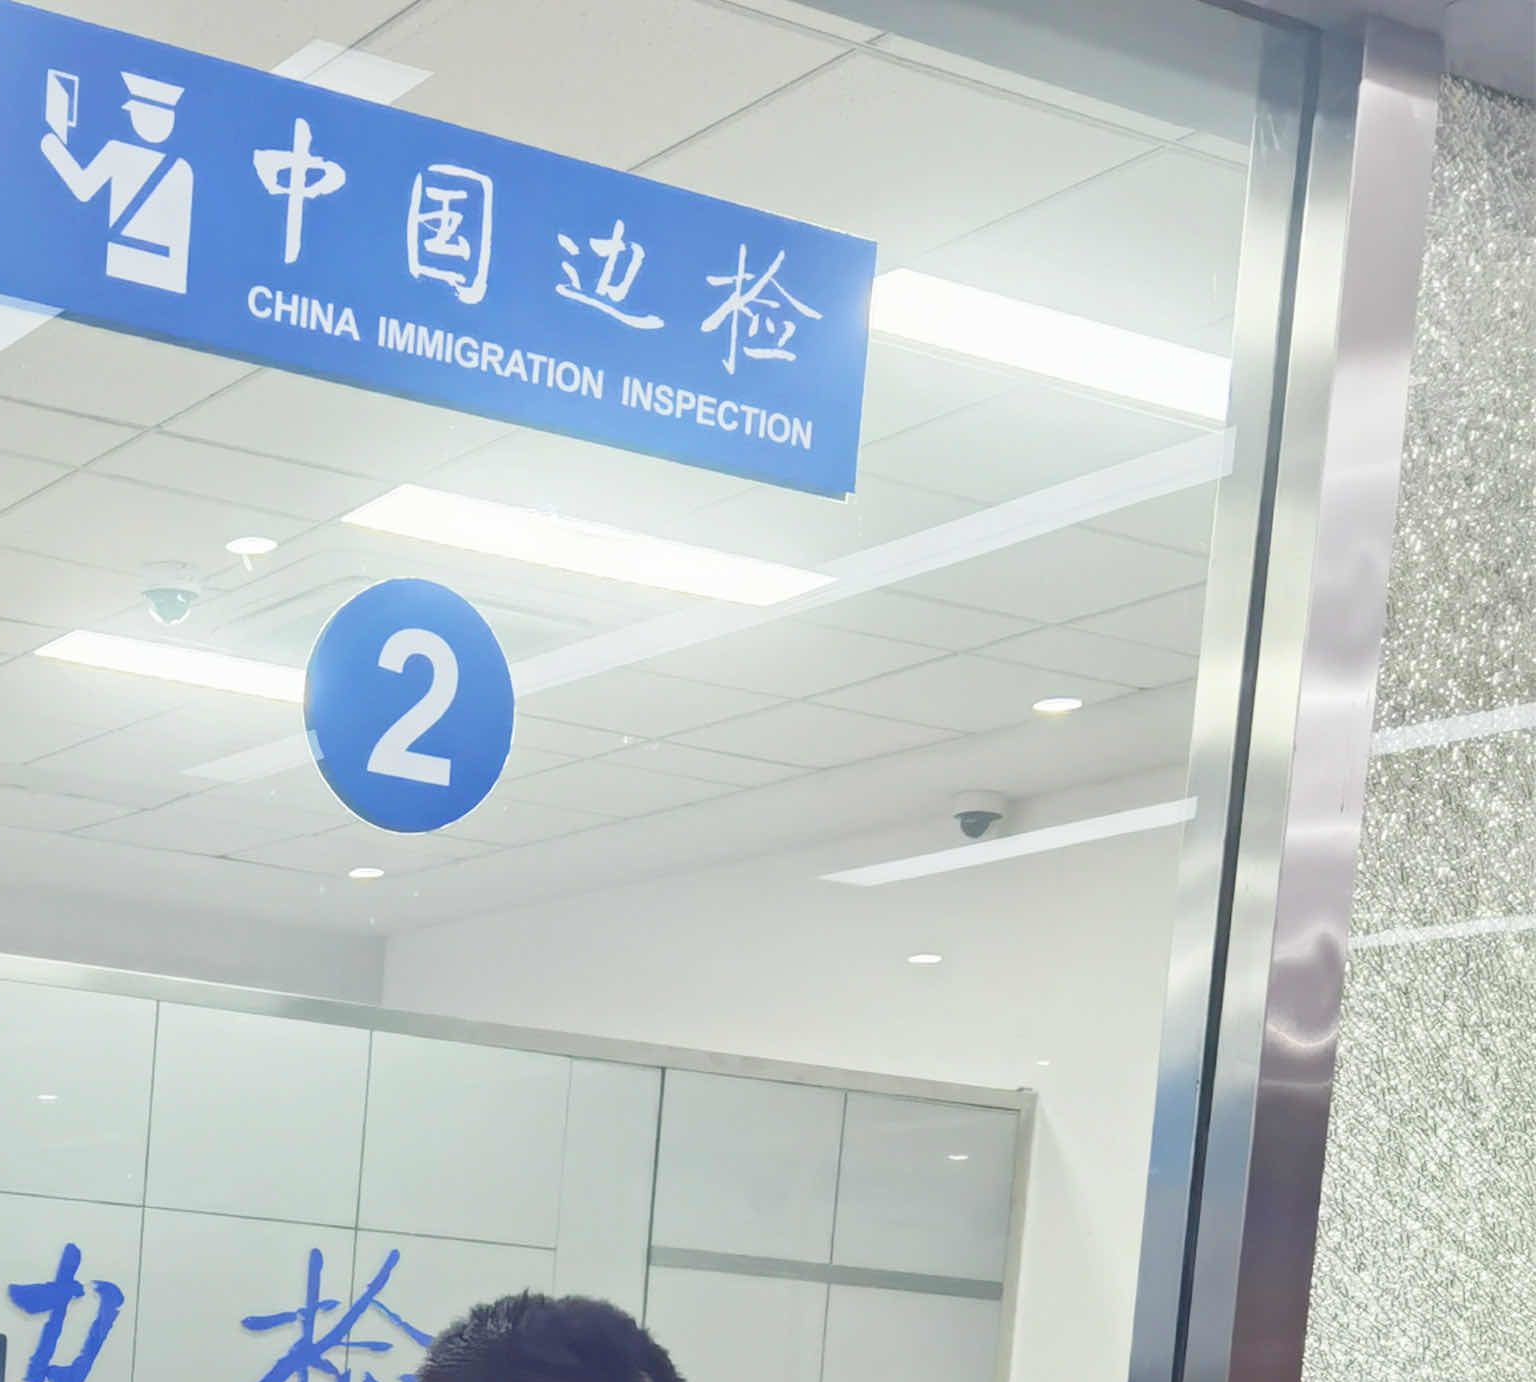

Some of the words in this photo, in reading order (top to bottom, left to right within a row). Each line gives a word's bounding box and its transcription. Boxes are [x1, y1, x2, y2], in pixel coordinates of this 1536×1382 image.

[252, 117, 823, 375] 中国边检
[247, 284, 360, 342] CHINA
[378, 315, 605, 400] IMMIGRATION
[620, 375, 813, 450] INSPECTION
[367, 628, 459, 786] 2
